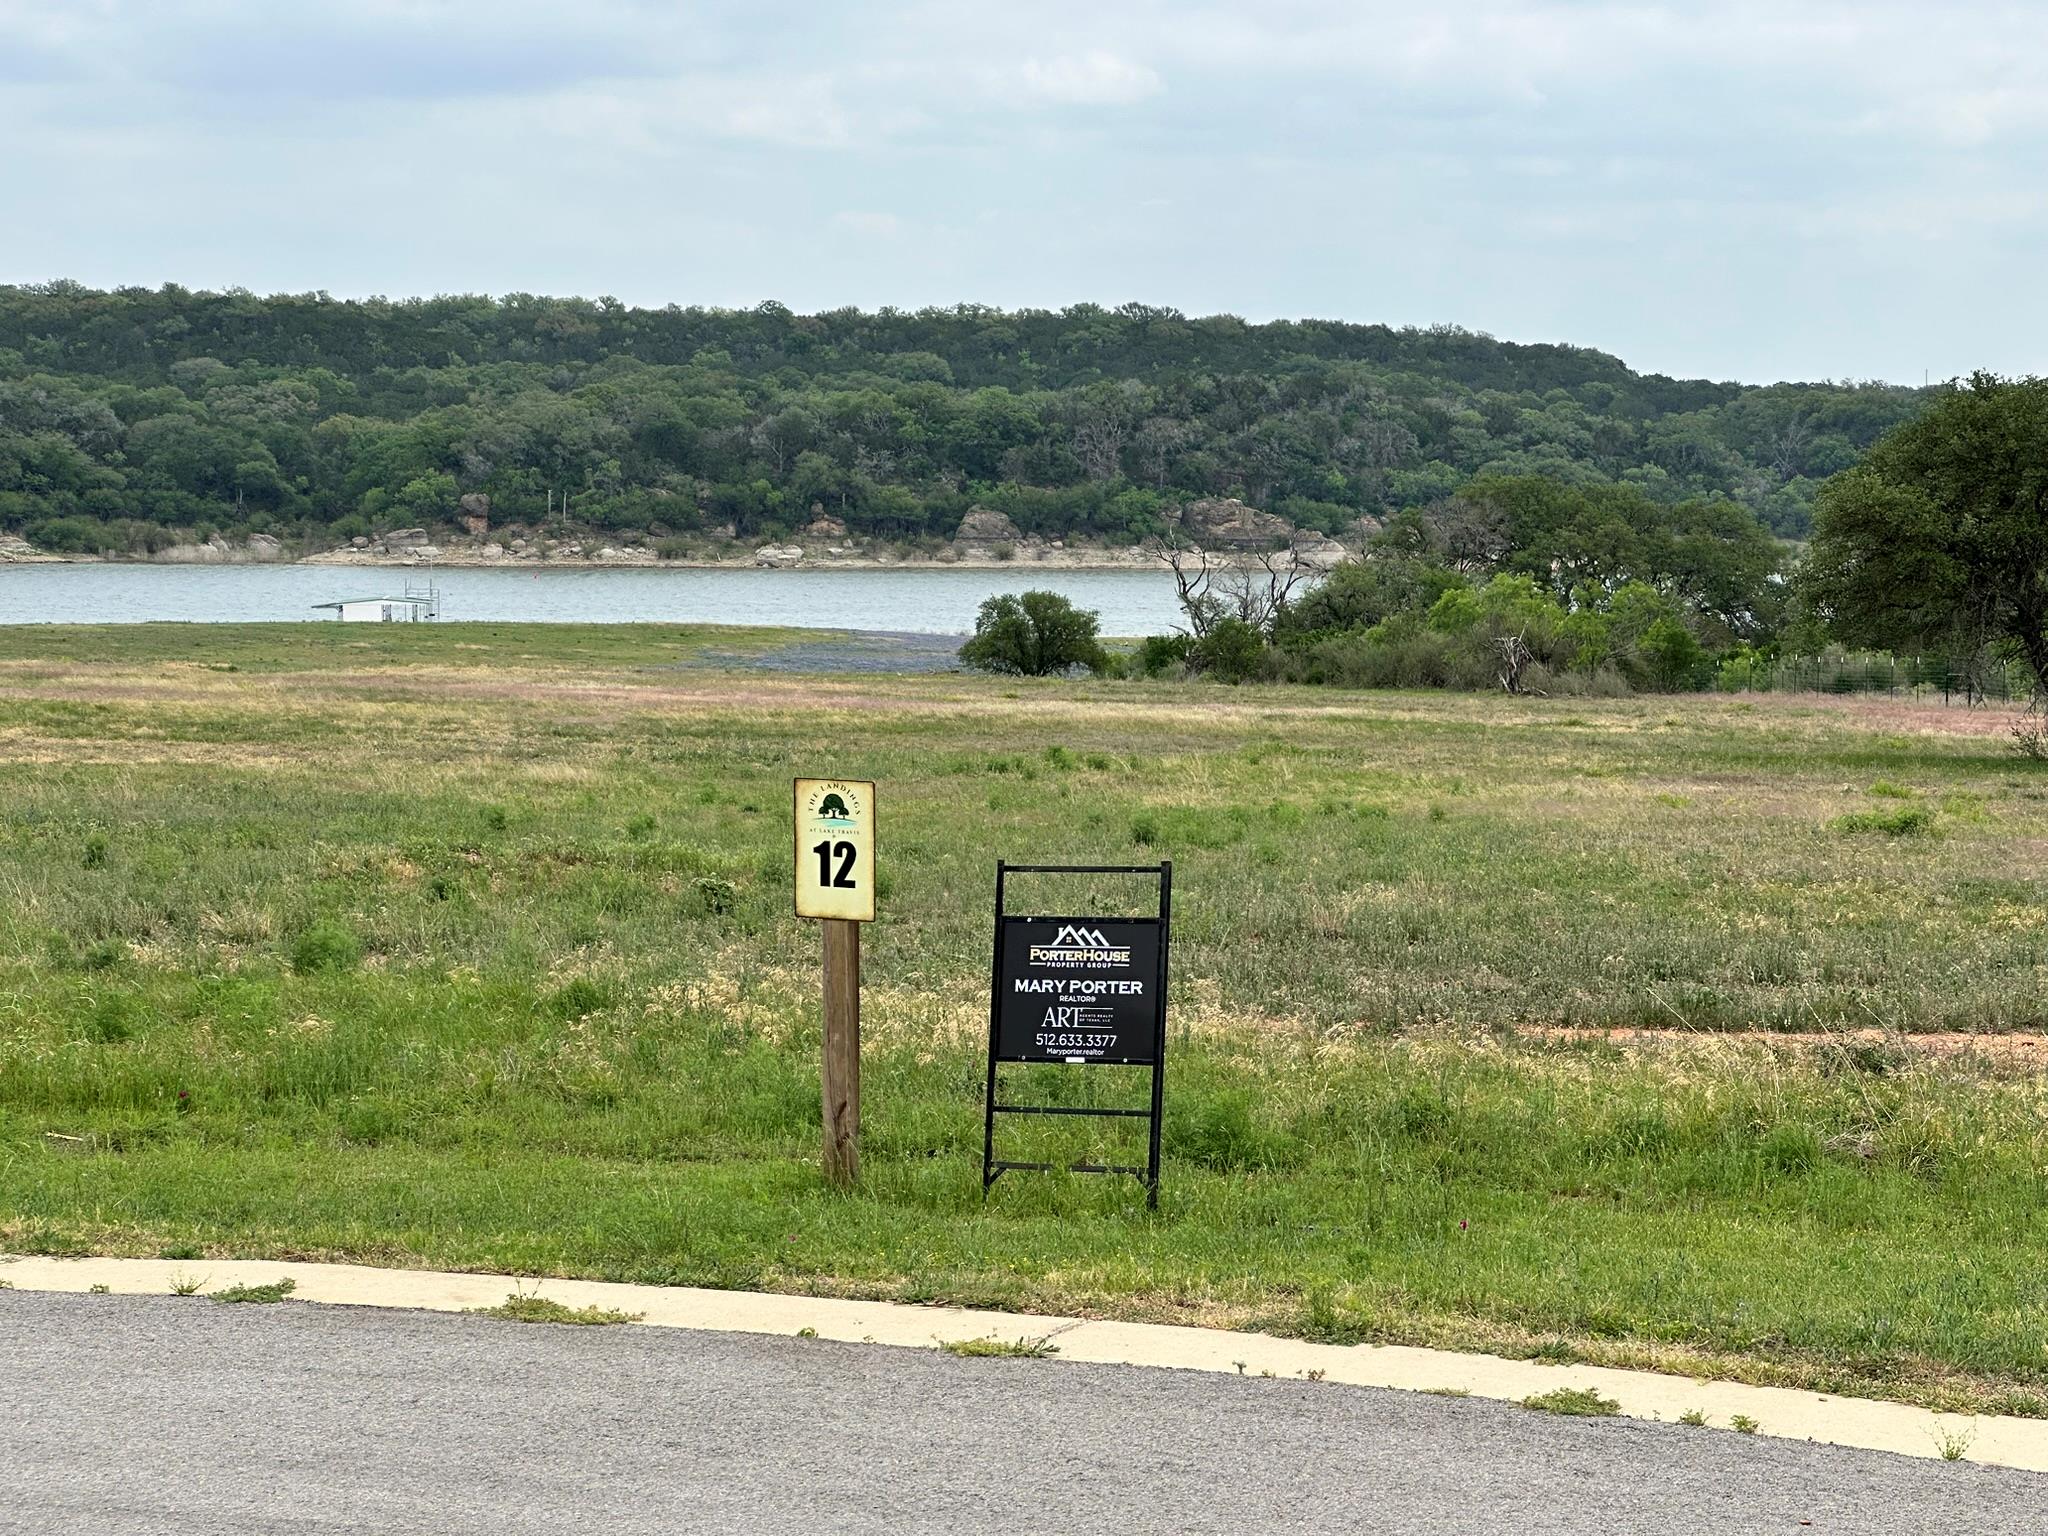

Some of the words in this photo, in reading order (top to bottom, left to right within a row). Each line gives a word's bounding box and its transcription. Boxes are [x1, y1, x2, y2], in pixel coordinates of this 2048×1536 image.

[808, 793, 818, 811] THE
[820, 783, 861, 815] LANDINGS
[813, 841, 857, 888] 12
[1014, 979, 1067, 993] MARY
[1069, 980, 1143, 995] PORTER
[1041, 1006, 1083, 1028] ART
[1035, 1033, 1117, 1047] 512.633.3377
[1046, 1047, 1105, 1056] Maryporter.realtor
